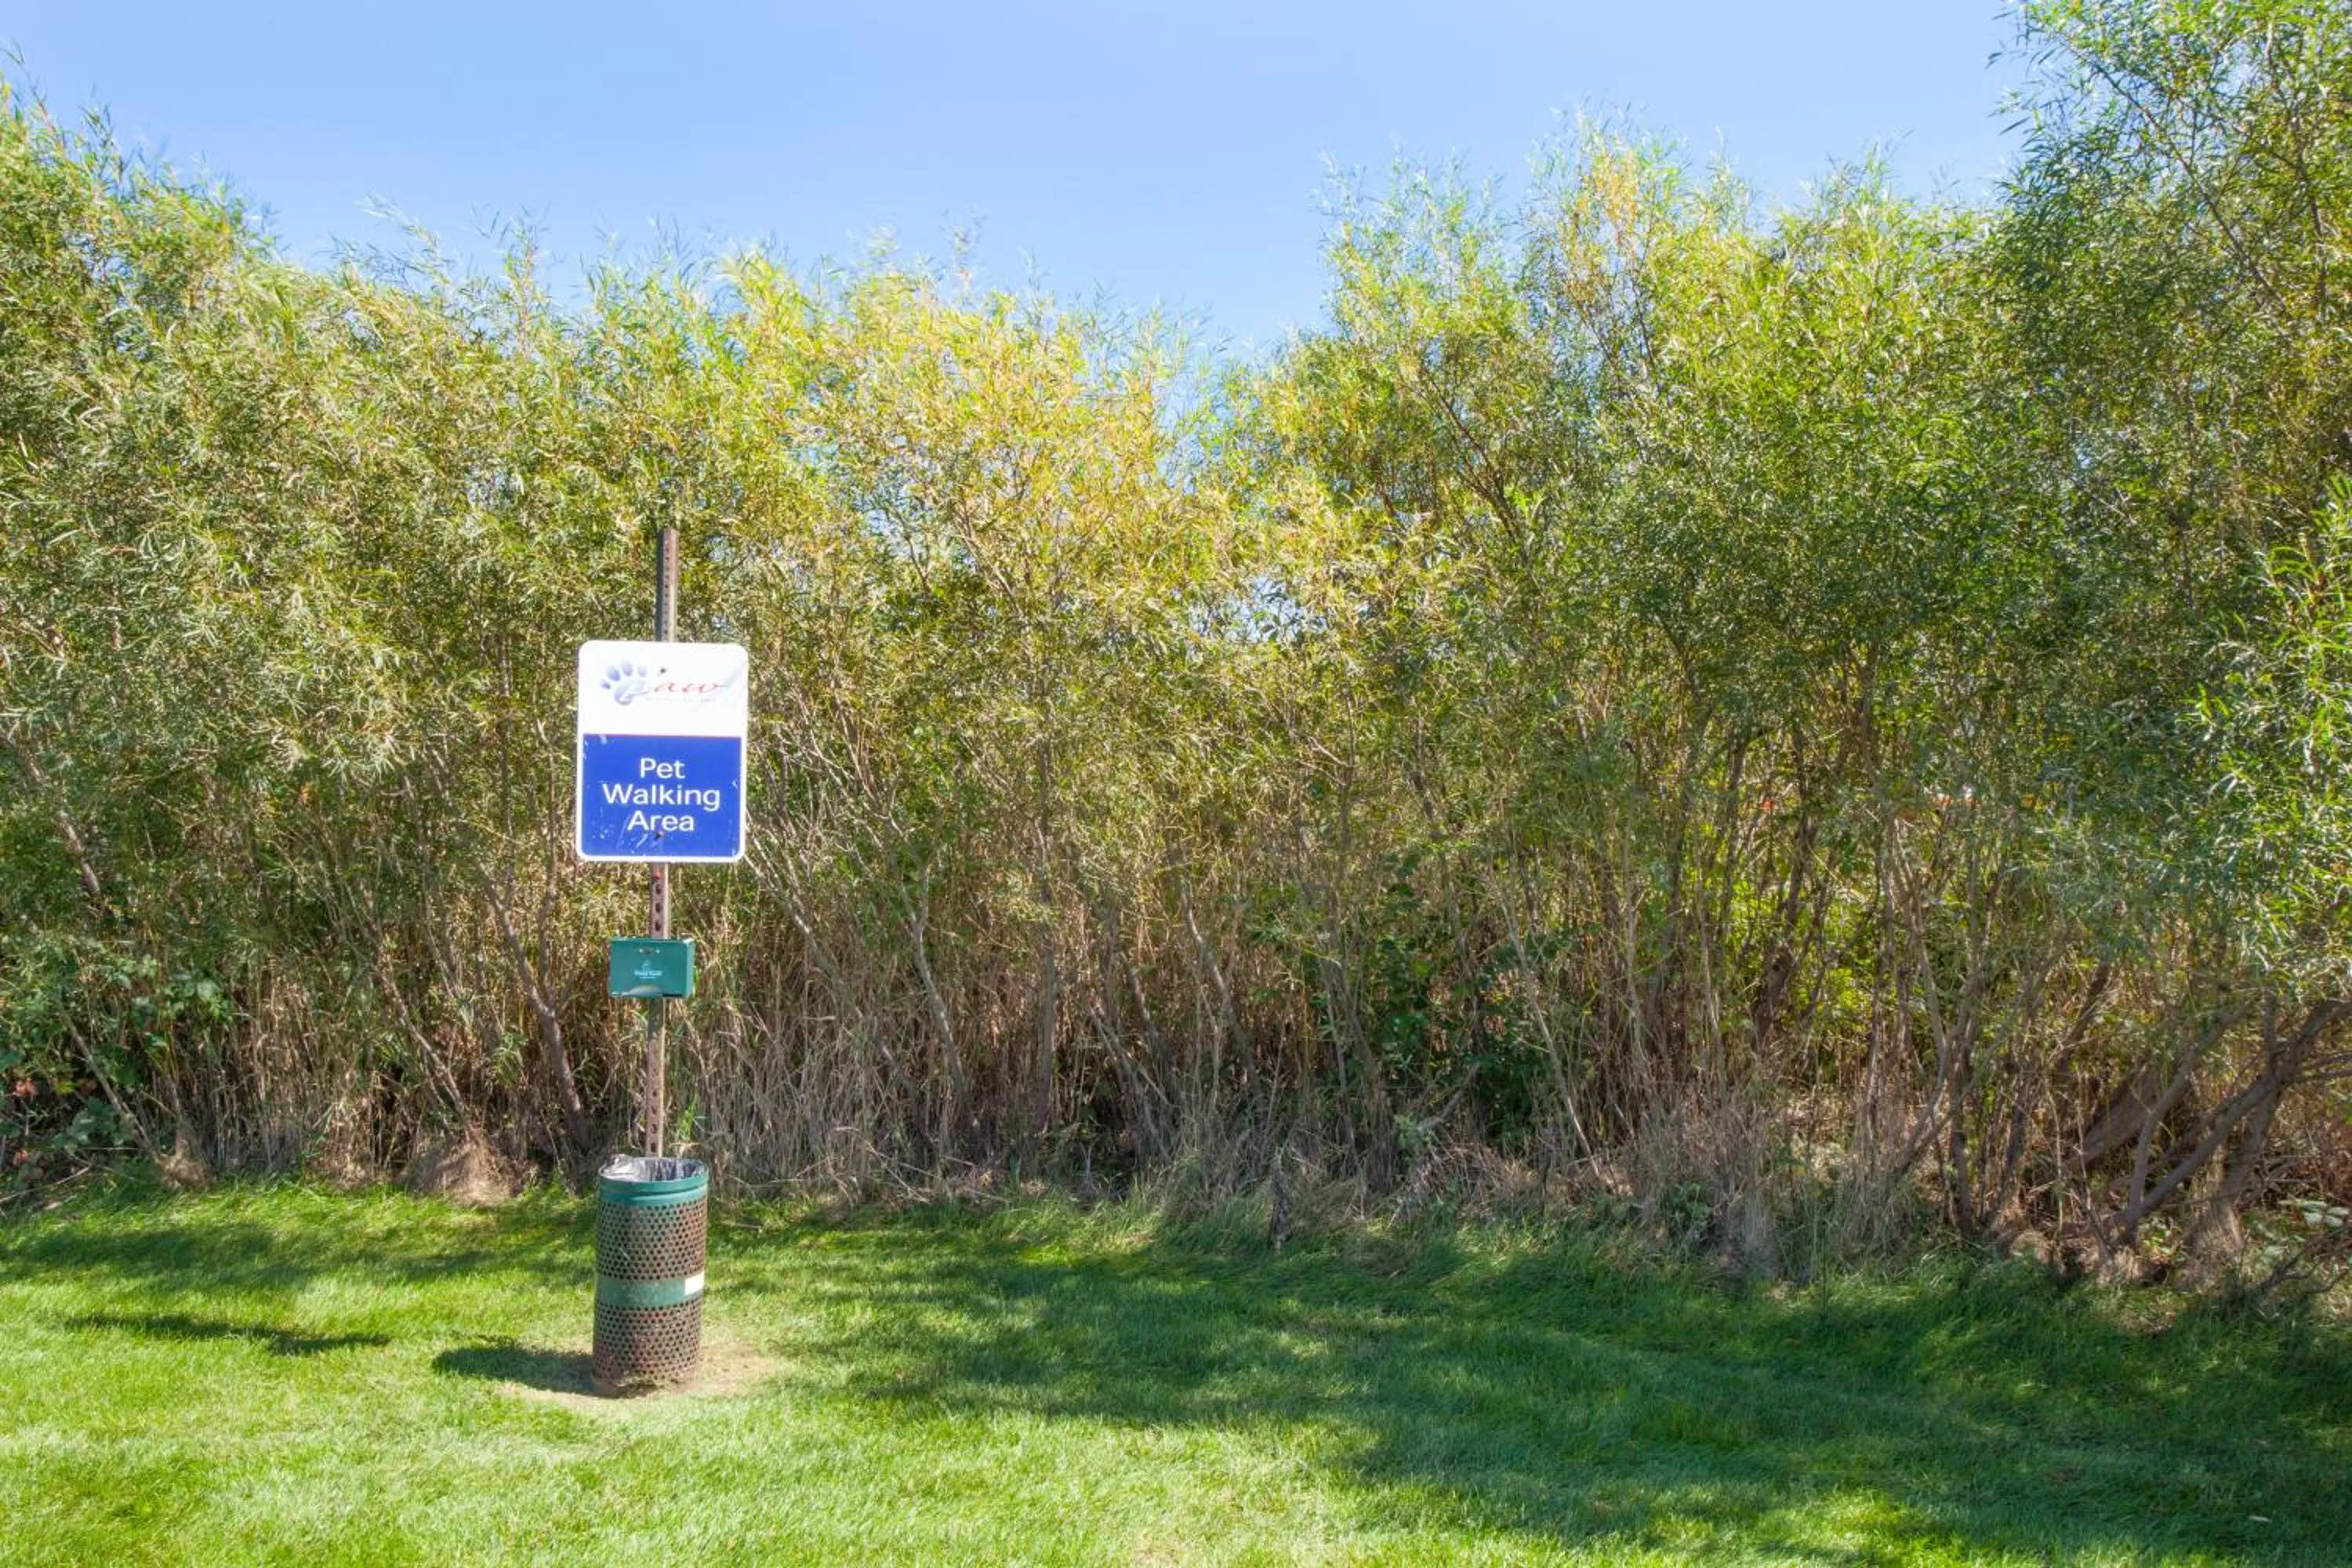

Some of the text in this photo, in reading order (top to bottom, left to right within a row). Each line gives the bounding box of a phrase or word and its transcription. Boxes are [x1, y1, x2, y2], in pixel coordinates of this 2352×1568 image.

[640, 757, 685, 779] Pet
[601, 783, 720, 812] Walking
[626, 810, 695, 832] Area
